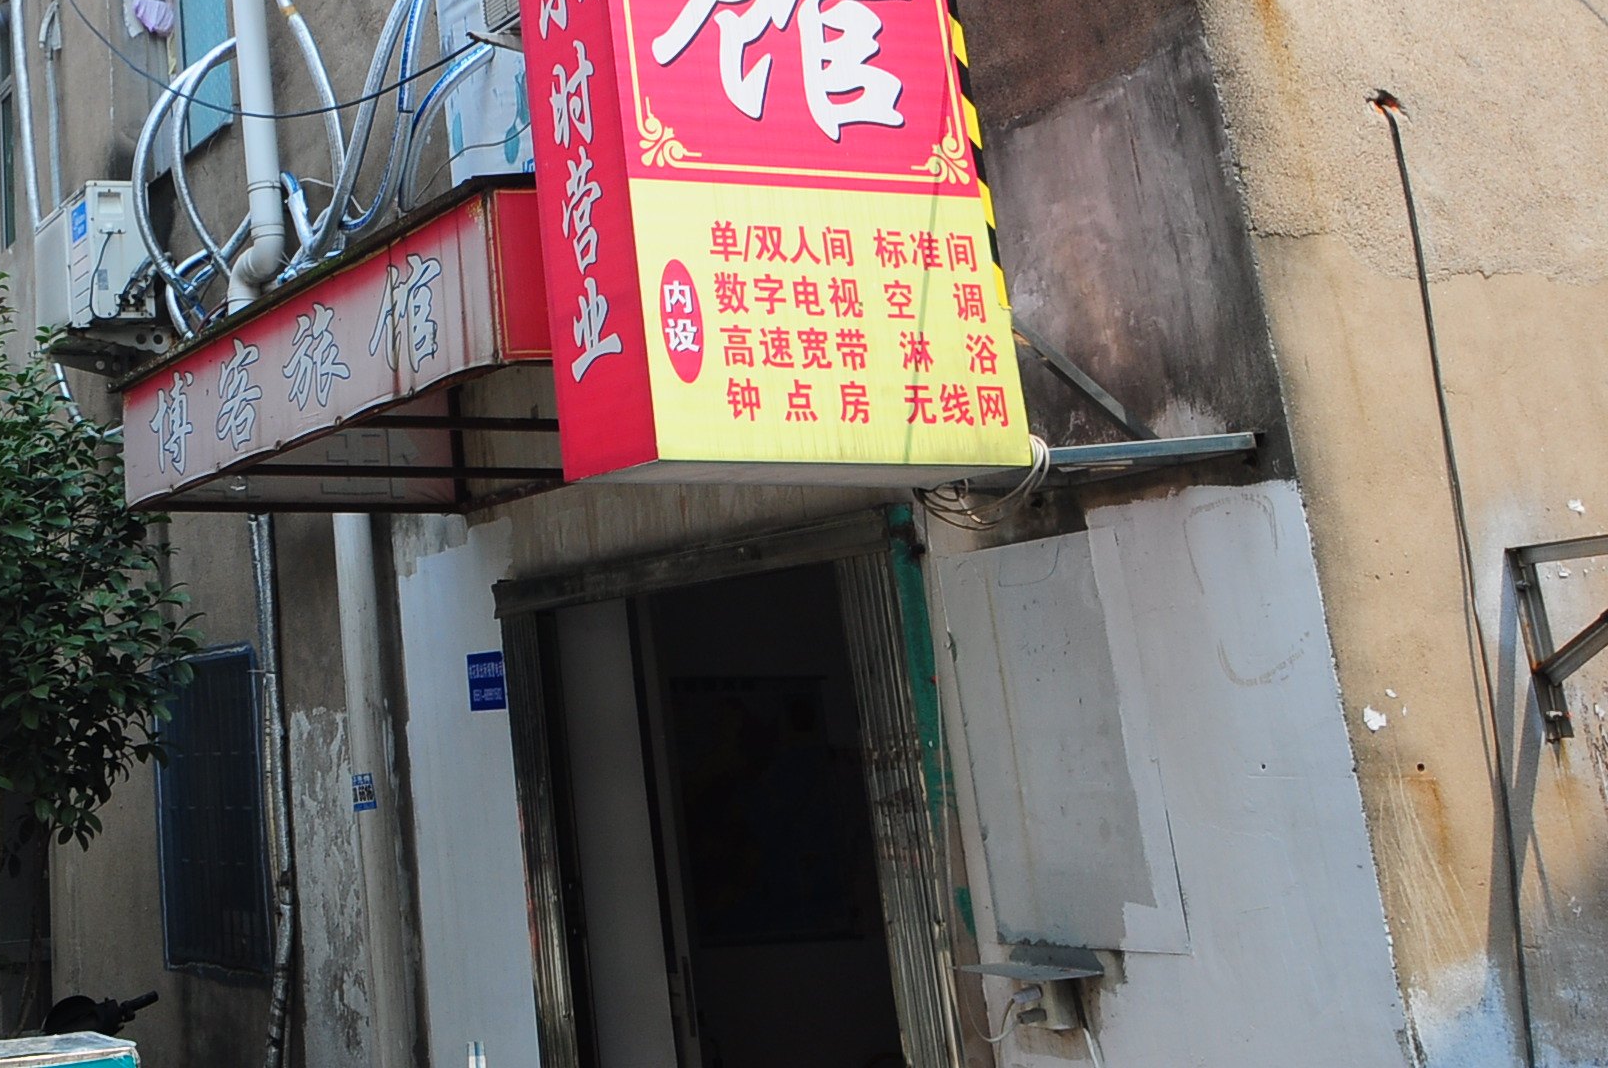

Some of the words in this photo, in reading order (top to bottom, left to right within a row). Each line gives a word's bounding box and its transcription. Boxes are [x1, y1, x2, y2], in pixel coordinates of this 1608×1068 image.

[709, 220, 855, 267] 单/双人间
[873, 228, 978, 273] 标准间
[664, 279, 701, 354] 内设
[714, 272, 863, 319] 数字电视
[150, 254, 441, 475] 博客旅馆
[719, 325, 868, 371] 高速宽带
[904, 383, 1009, 427] 无线网
